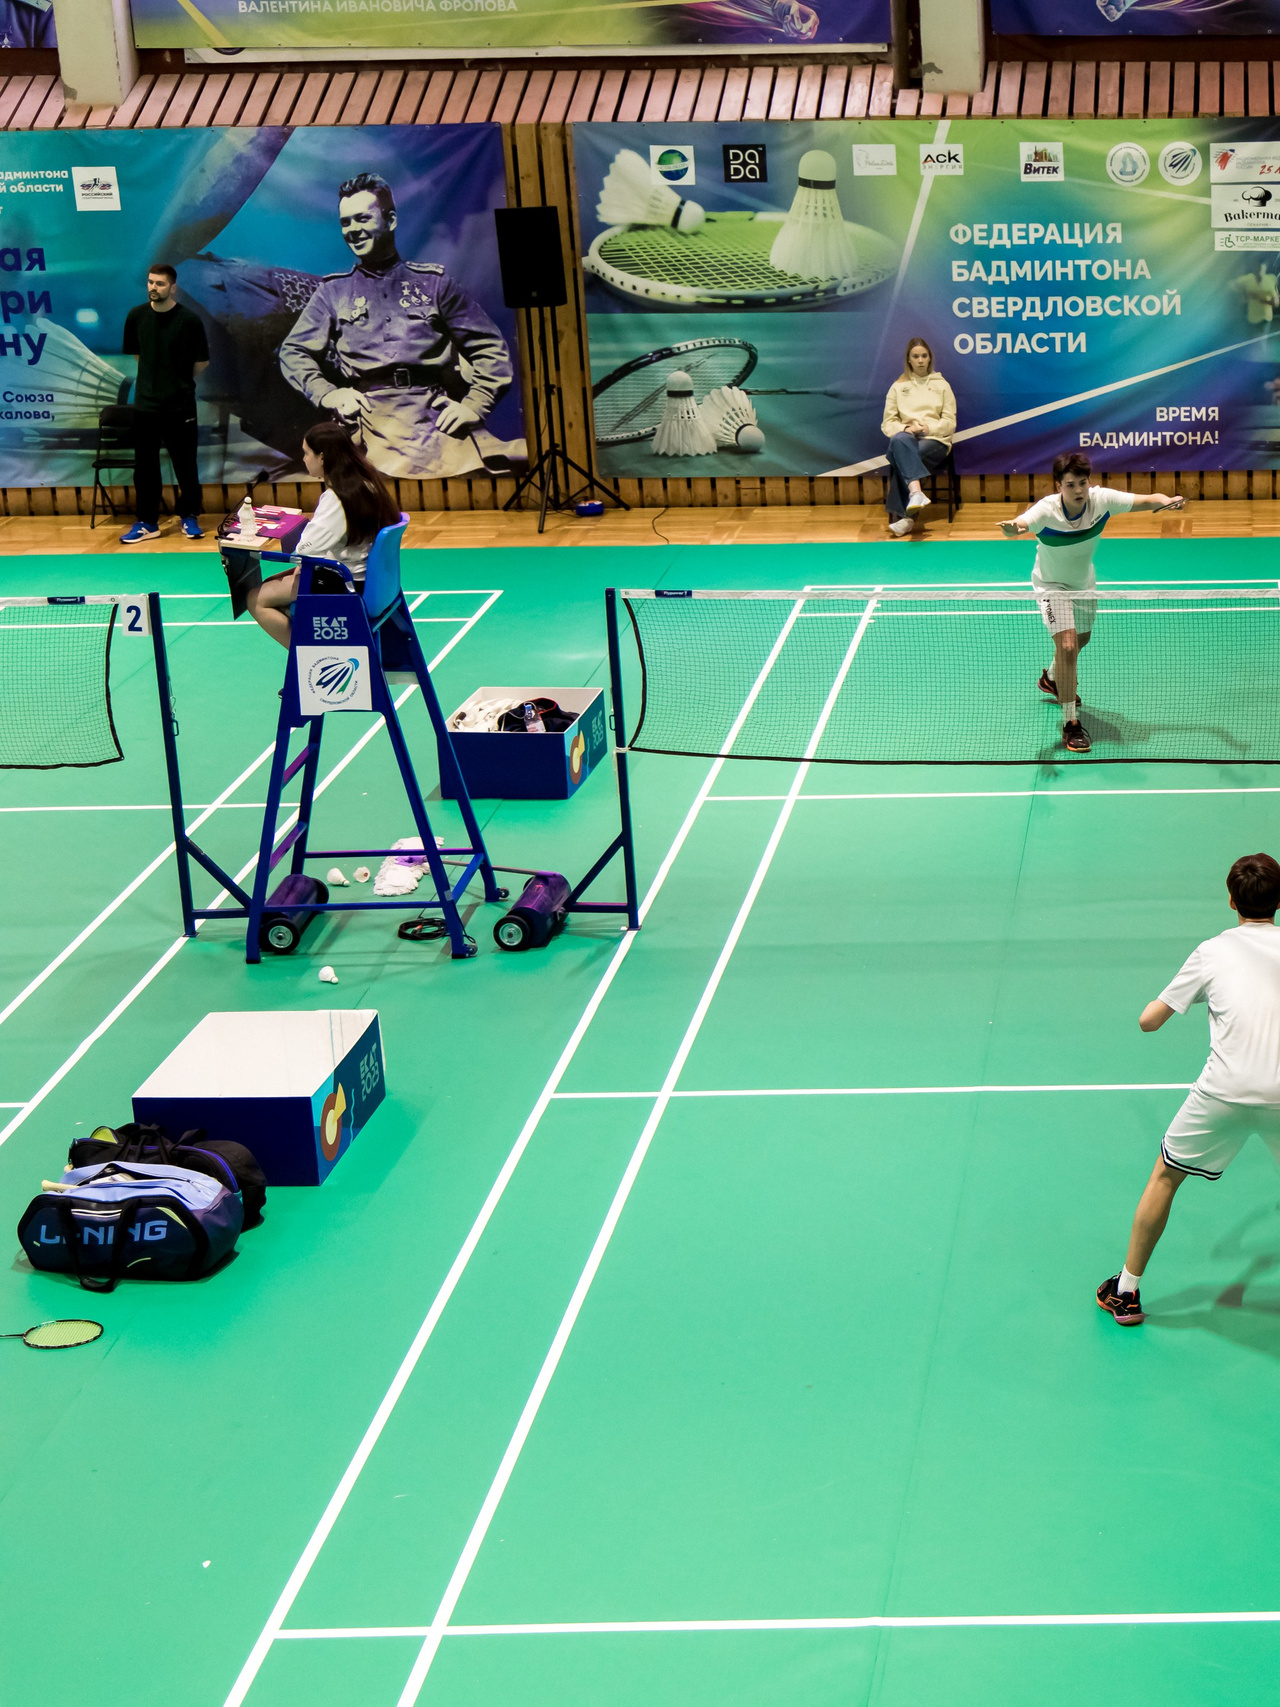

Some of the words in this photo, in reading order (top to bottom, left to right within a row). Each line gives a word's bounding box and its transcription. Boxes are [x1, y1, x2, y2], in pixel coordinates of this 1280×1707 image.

[238, 0, 333, 13] ВАЛЕНТИНА
[337, 0, 437, 13] ИВАНОВИЧА
[440, 0, 518, 12] ФРОЛОВА
[1259, 164, 1273, 175] 25
[10, 182, 64, 193] области
[949, 222, 1123, 249] ФЕДЕРАЦИЯ
[951, 258, 1152, 285] БАДМИНТОНА
[952, 288, 1182, 321] СВЕРДЛОВСКОЙ
[953, 331, 1087, 355] ОБЛАСТИ
[2, 391, 55, 403] Союза
[1156, 406, 1219, 422] ВРЕМЯ
[1079, 430, 1219, 449] БАДМИНТОНА!
[126, 605, 143, 632] 2
[312, 616, 347, 627] EKAT
[1045, 603, 1057, 625] YONEX
[314, 627, 348, 640] 2023
[360, 1042, 377, 1080] EKAT
[361, 1061, 380, 1102] 2023
